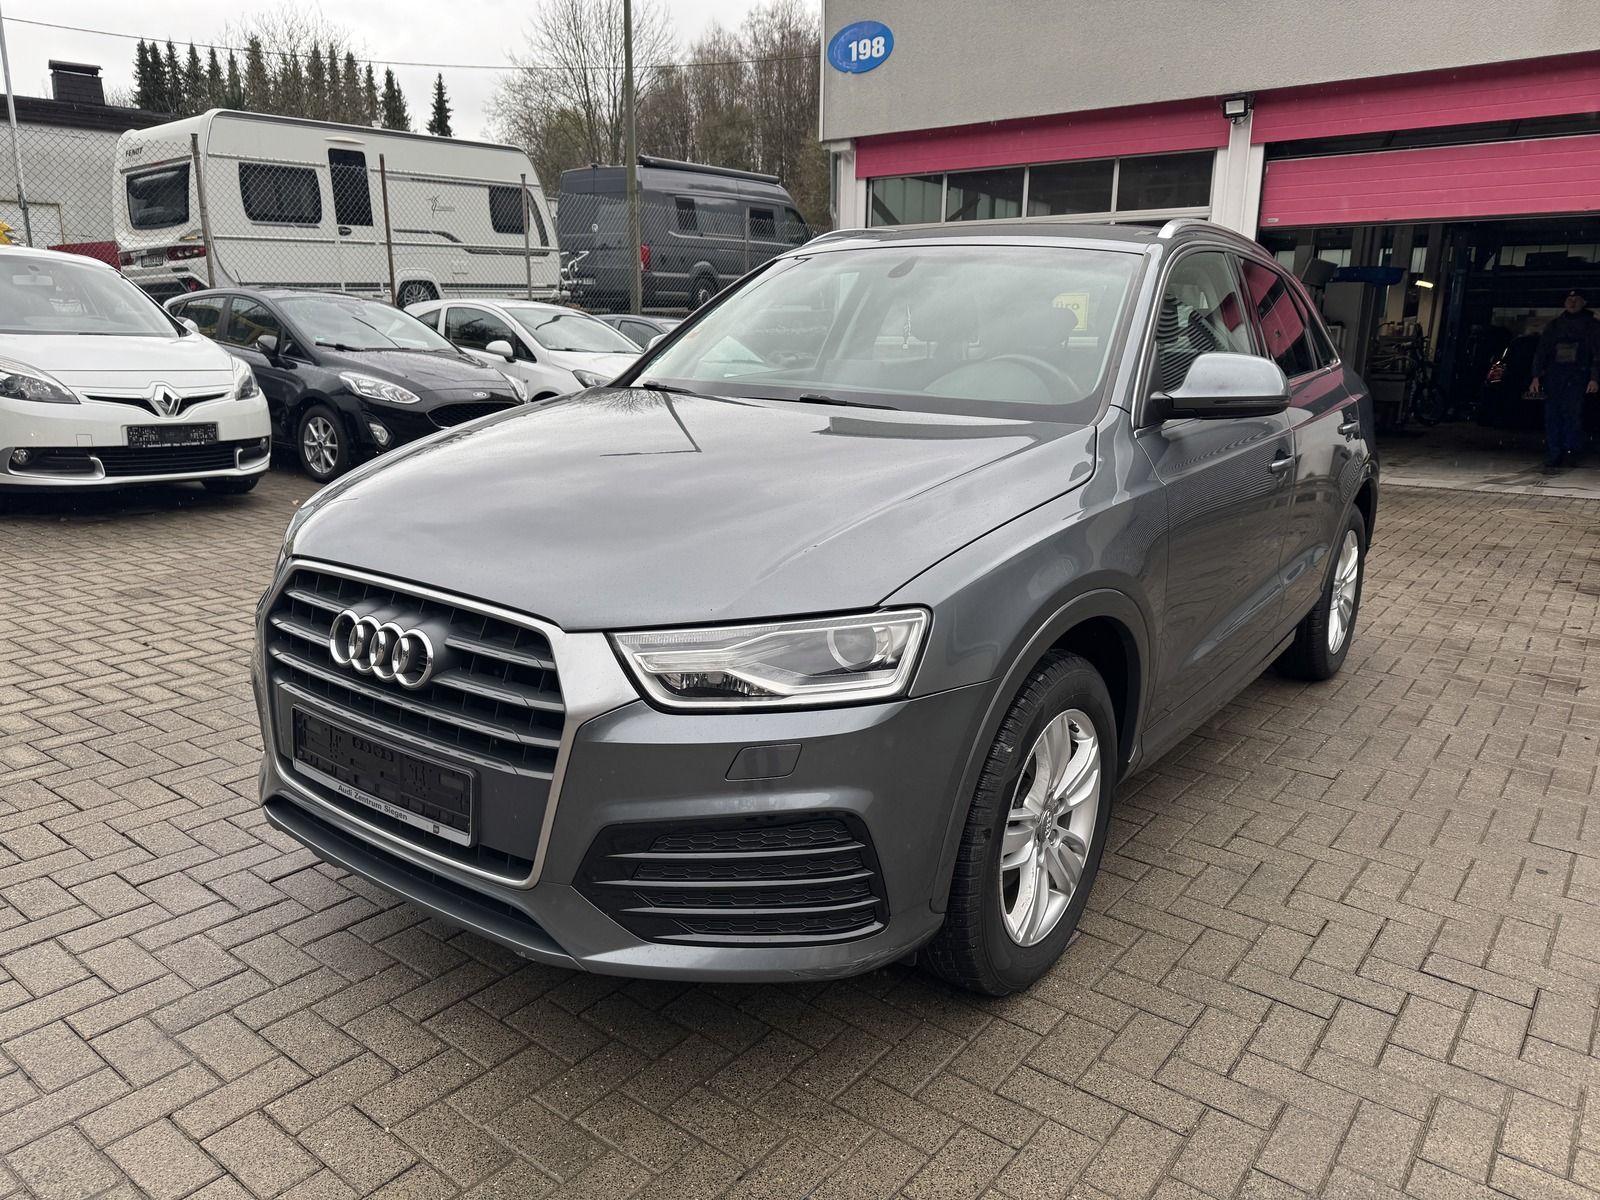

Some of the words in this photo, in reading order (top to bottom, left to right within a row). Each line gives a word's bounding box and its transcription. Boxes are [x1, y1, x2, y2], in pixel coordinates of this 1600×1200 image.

[848, 36, 885, 62] 198
[125, 146, 143, 157] FENDT
[338, 784, 353, 797] Audi
[354, 791, 382, 811] Zentrum
[383, 805, 408, 821] Siegen
